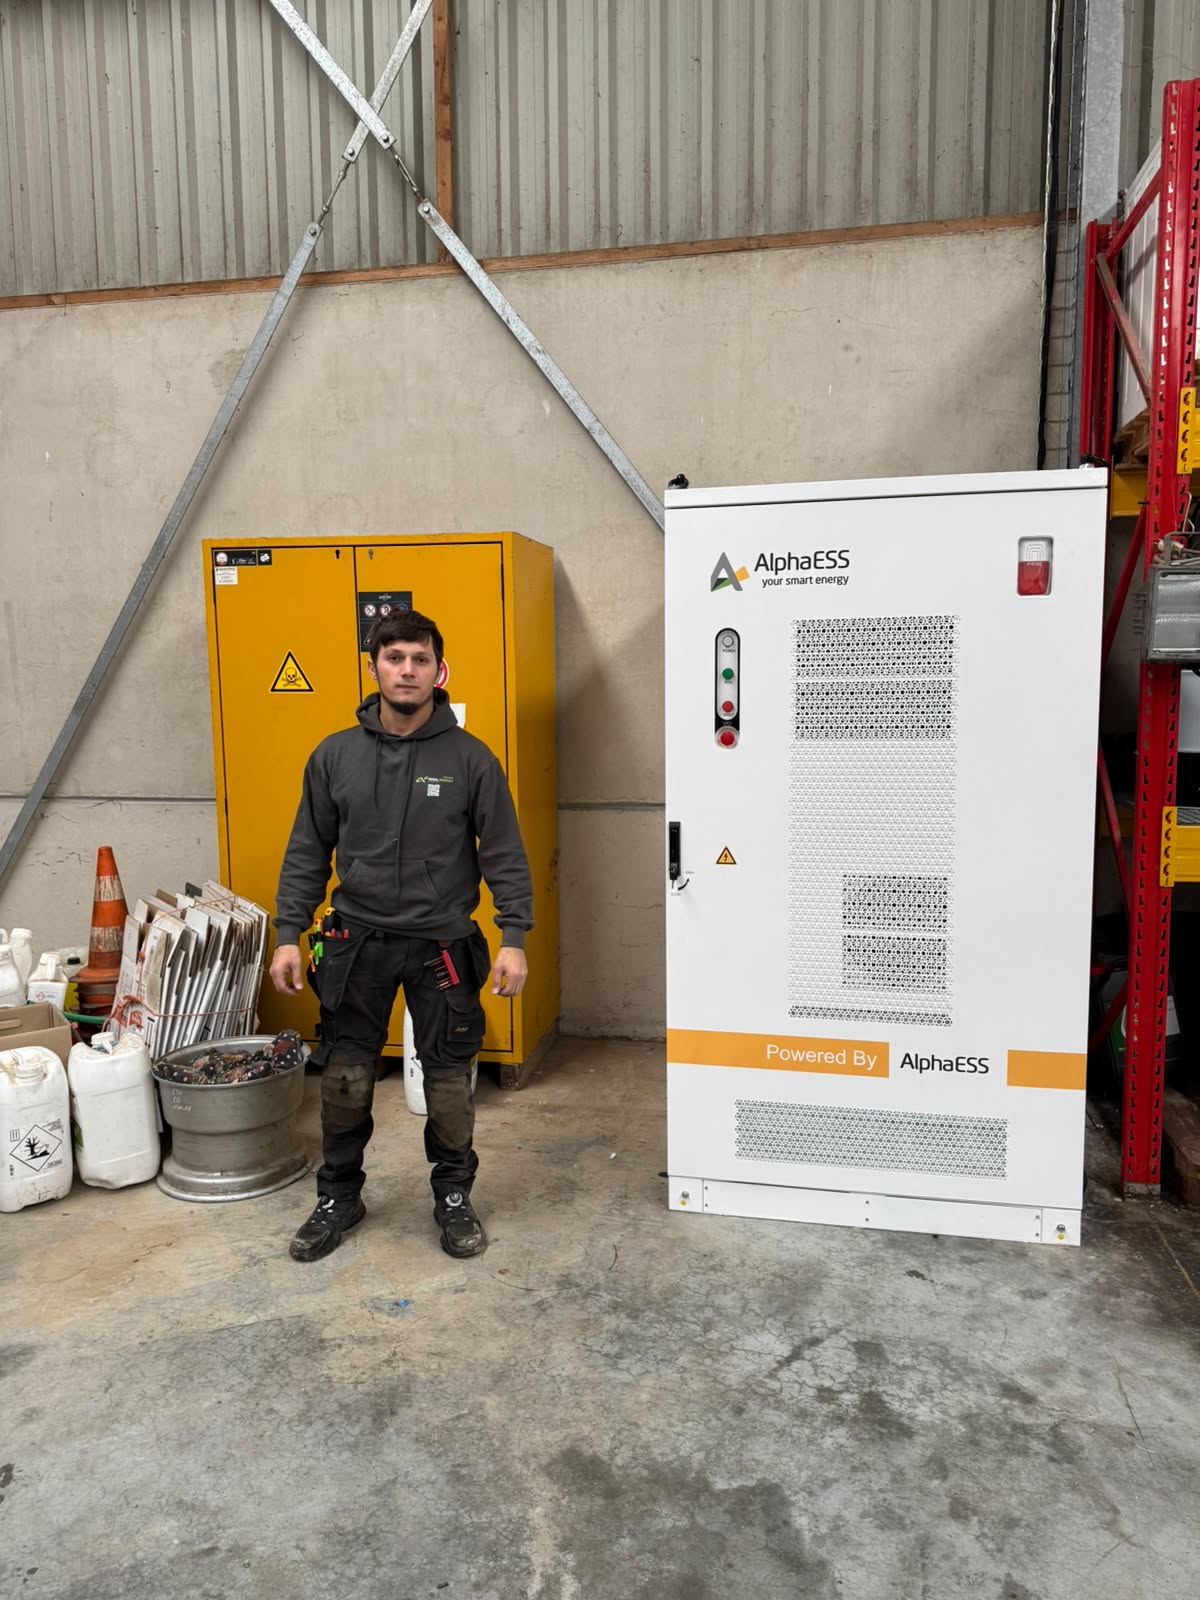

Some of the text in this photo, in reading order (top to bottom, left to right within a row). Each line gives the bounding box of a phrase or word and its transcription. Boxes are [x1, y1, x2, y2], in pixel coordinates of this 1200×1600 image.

[754, 549, 850, 576] AlphaESS
[762, 575, 849, 588] your smart energy
[766, 1044, 989, 1074] Powered By AlphaESS
